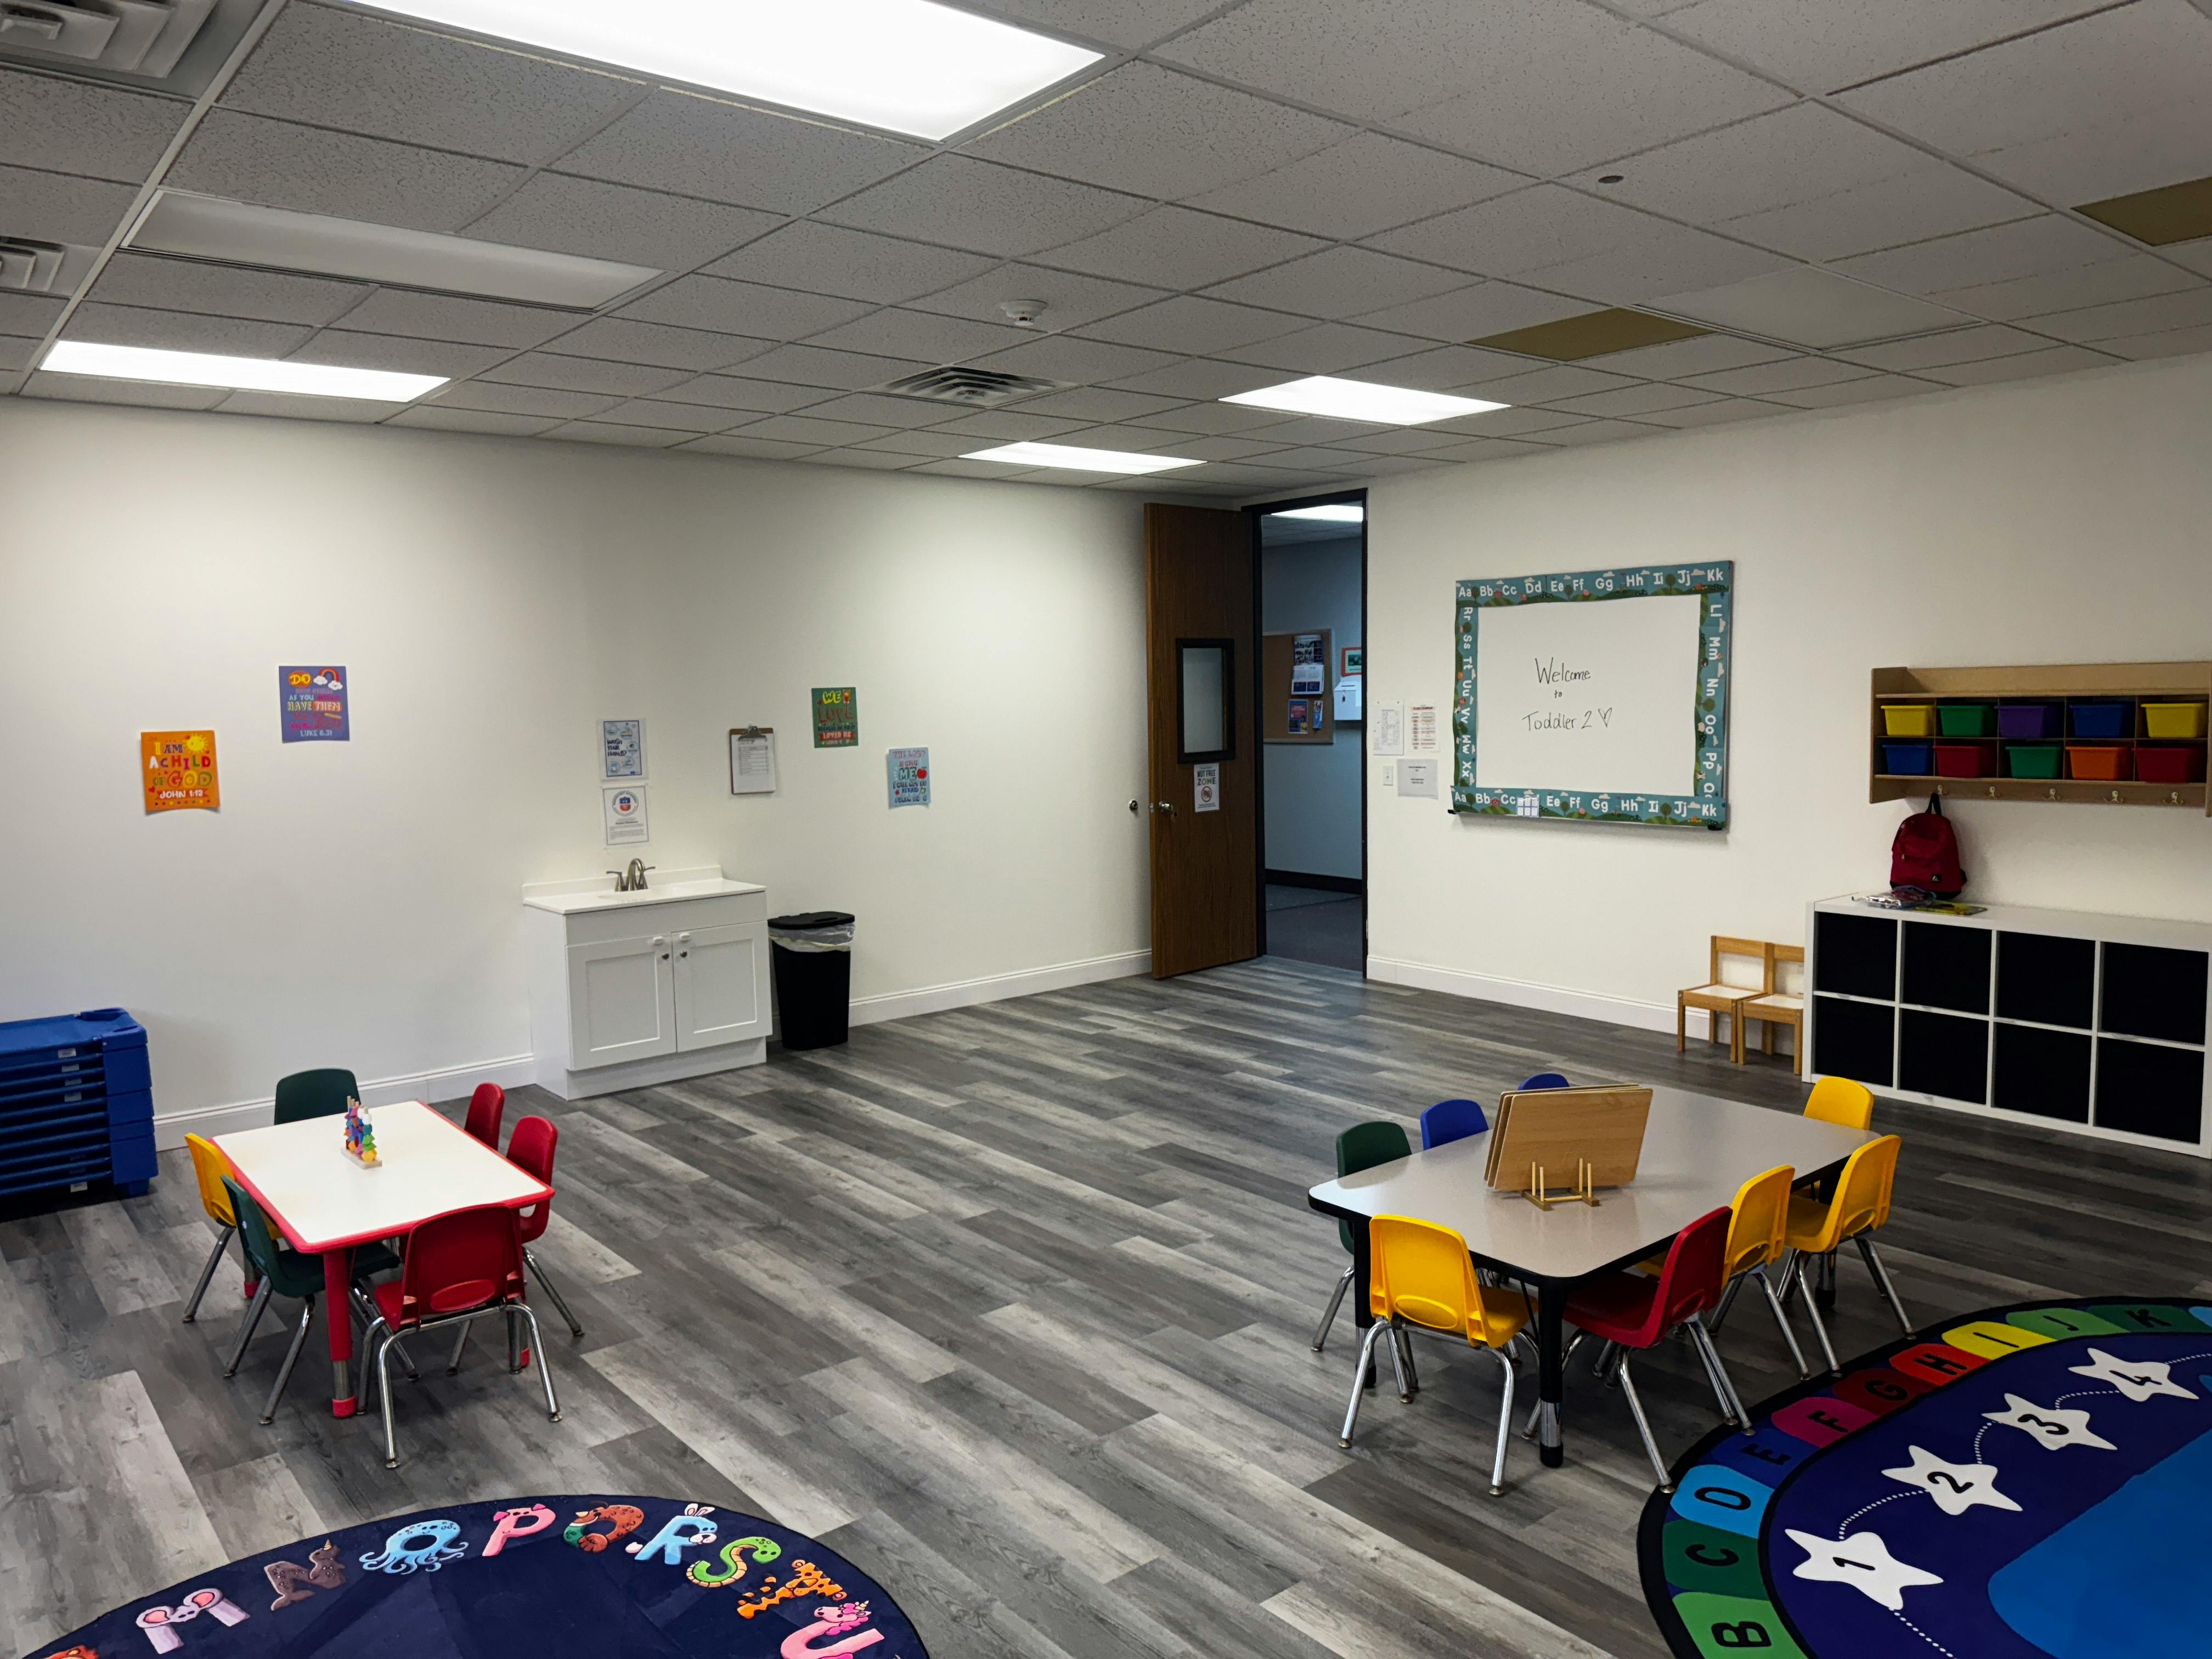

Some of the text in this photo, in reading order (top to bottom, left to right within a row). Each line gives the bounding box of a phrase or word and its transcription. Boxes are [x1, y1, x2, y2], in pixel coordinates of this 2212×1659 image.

[1459, 568, 1723, 597] Aa Bb Cc Dd Ee Ff Gg Hh Ii Jj Kk
[1708, 636, 1721, 661] Mm
[289, 673, 312, 685] DO
[1535, 657, 1591, 685] Welcome
[1460, 606, 1474, 777] Rr Ss Tt Uu Vv Ww Xx
[1554, 689, 1562, 698] to
[1706, 678, 1719, 697] Nn
[287, 701, 341, 712] HAVE THEM
[822, 691, 842, 704] WE
[1522, 710, 1592, 731] Toddler 2
[1705, 714, 1717, 735] Oo
[154, 742, 183, 755] I AM
[149, 754, 211, 770] A CHILD
[1702, 752, 1717, 770] Pp
[152, 770, 213, 788] OF GOD
[1197, 777, 1216, 786] ZONE
[159, 790, 186, 799] JOHN
[1454, 792, 1717, 817] Aa Bb Cc Ee Ff Gg Hh Ii Jj Kk
[1685, 1309, 2173, 1648] B C D E F G H I J K
[1832, 1370, 2163, 1571] 1 2 3 4
[482, 1503, 557, 1557] P
[686, 1536, 782, 1588] S
